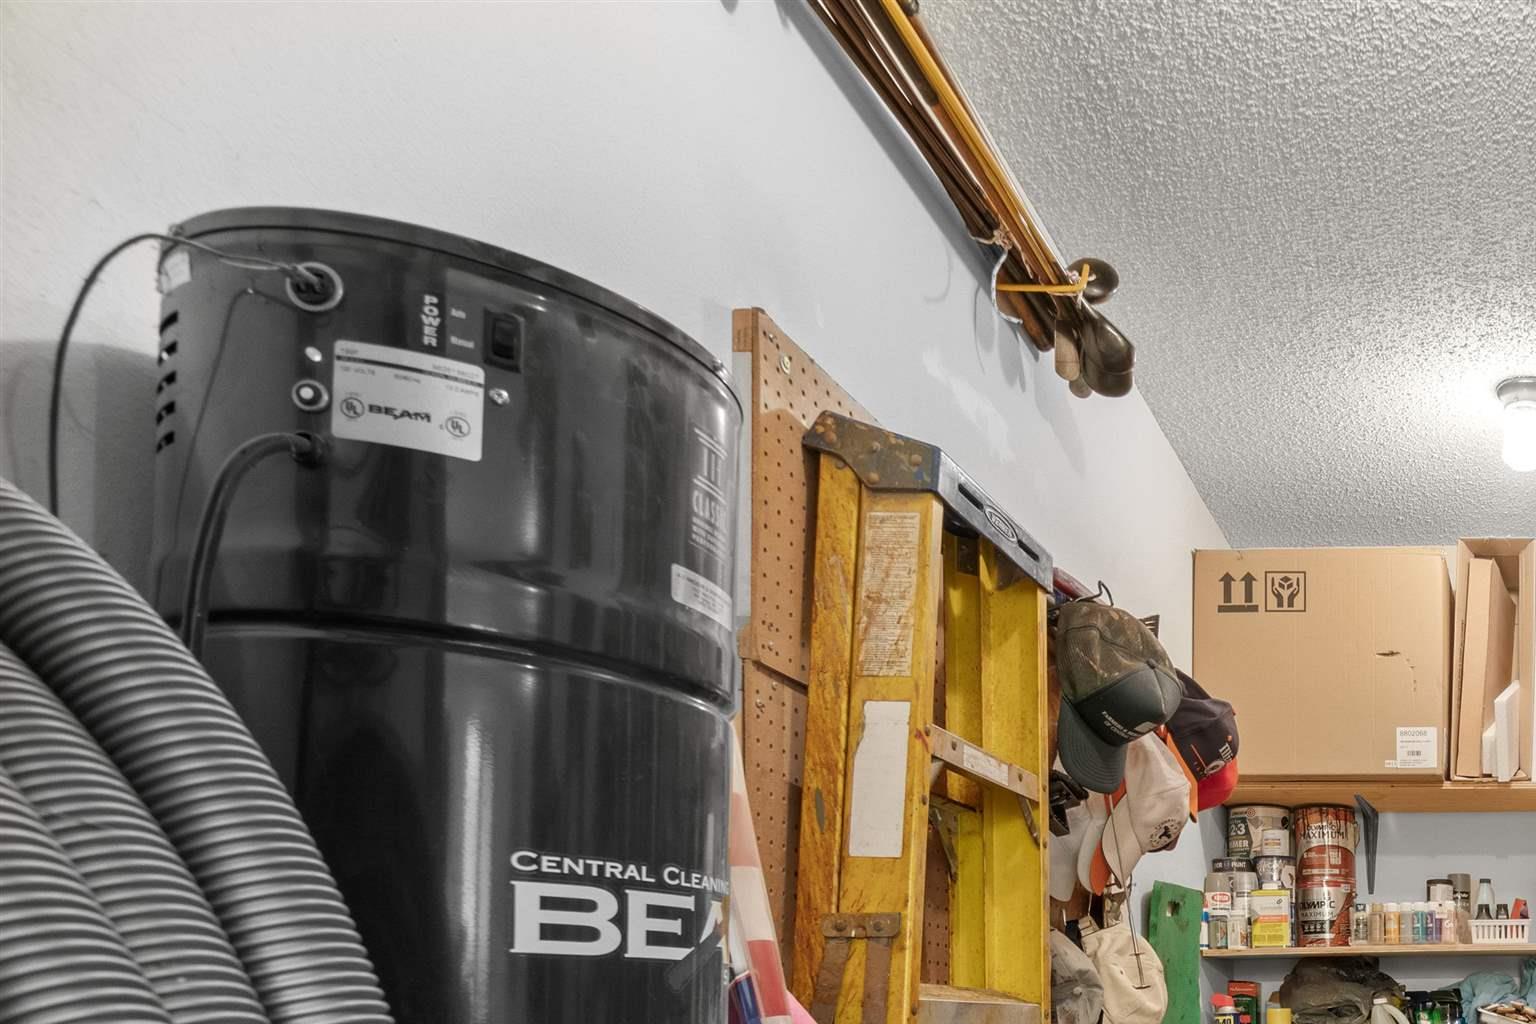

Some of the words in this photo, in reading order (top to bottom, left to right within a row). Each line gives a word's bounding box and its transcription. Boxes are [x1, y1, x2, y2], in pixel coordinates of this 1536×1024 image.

[421, 294, 441, 347] POWER
[368, 404, 432, 423] BEAM
[510, 850, 656, 883] CENTRAL
